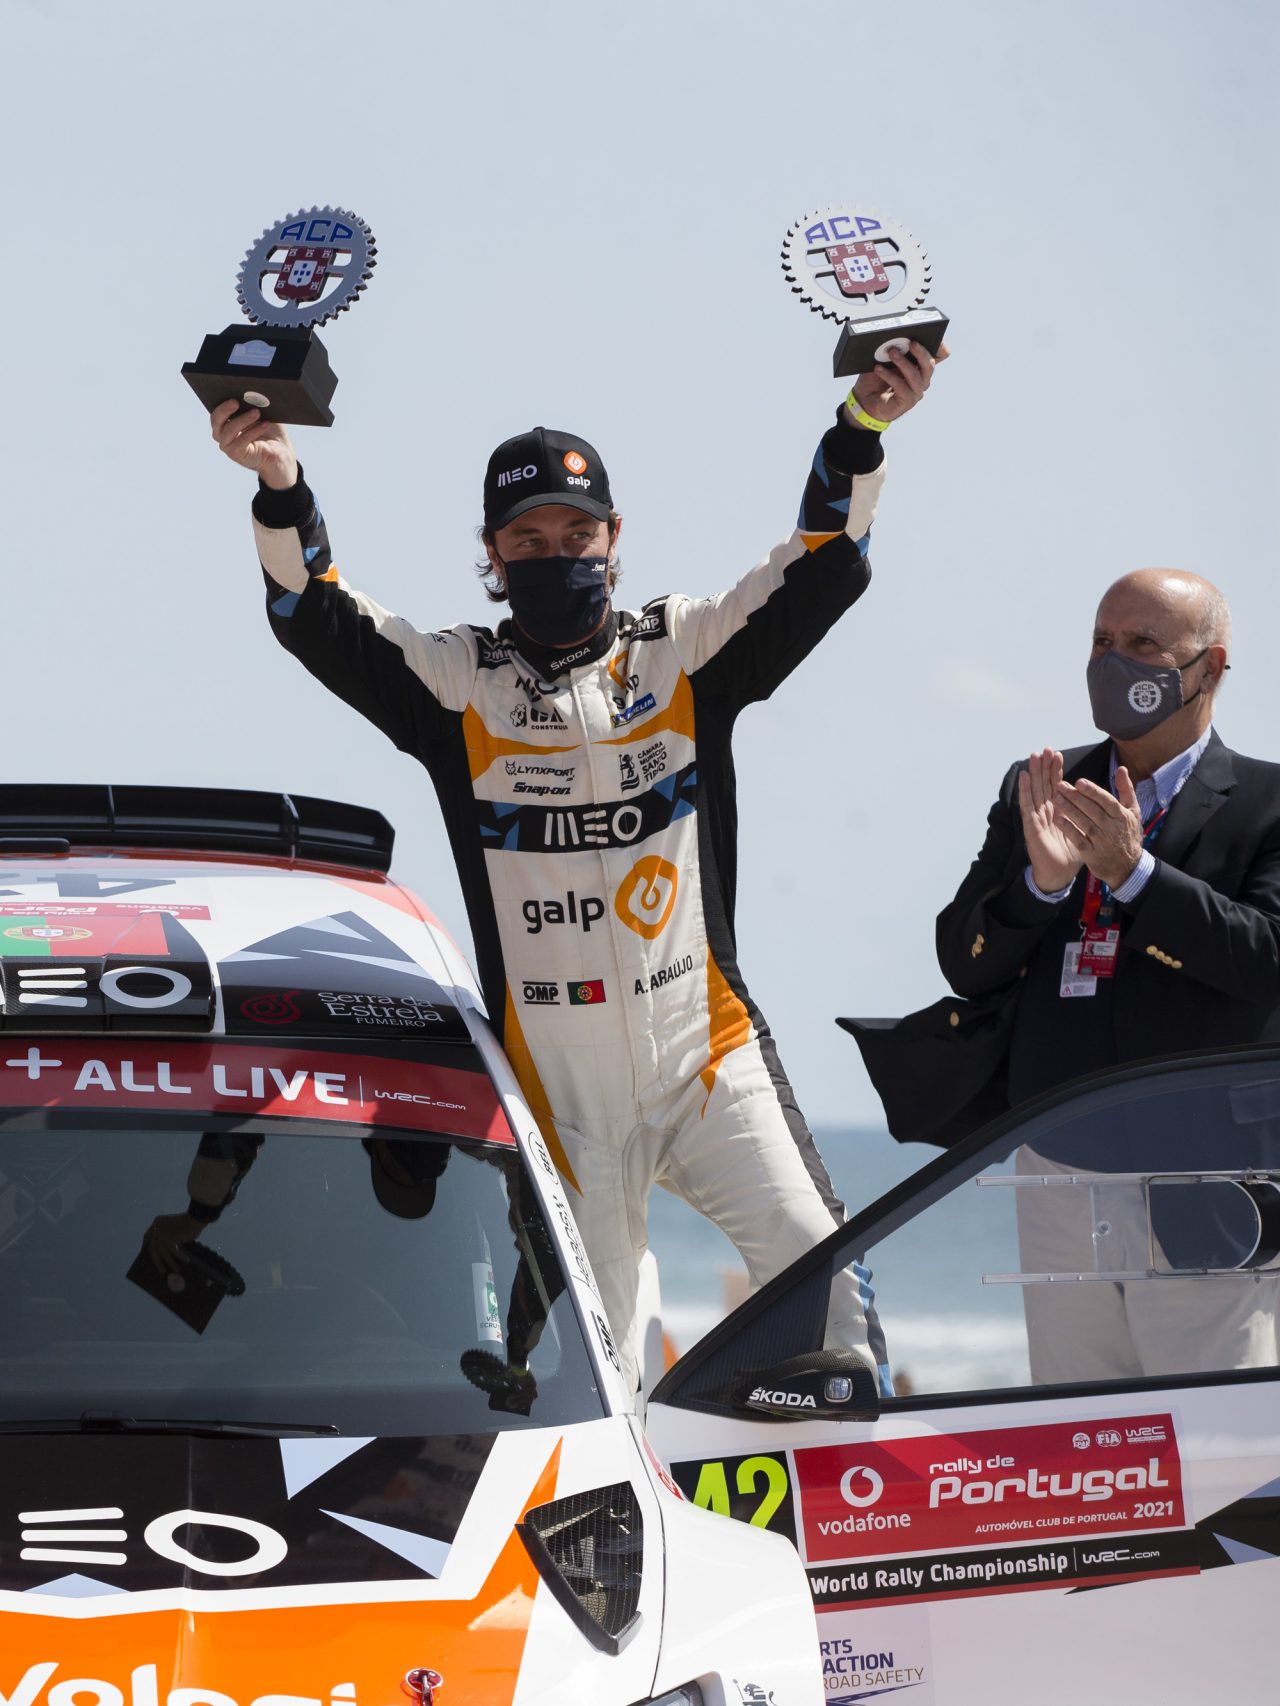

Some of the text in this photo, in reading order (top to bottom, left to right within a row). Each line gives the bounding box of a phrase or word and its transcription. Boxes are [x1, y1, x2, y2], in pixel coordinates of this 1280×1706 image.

[279, 219, 354, 243] ACP
[804, 216, 882, 244] ACP
[498, 464, 538, 487] MEO
[567, 475, 590, 489] galp
[513, 782, 571, 796] Snap-on
[544, 805, 642, 846] MEO
[523, 891, 605, 934] galp
[650, 955, 693, 990] ARAÚJO
[318, 992, 434, 1007] Serra da
[523, 983, 559, 1002] OMP
[324, 1002, 446, 1022] Estrela
[356, 1017, 426, 1027] FUMEIRO
[74, 1060, 192, 1094] ALL
[213, 1065, 349, 1106] LIVE
[749, 1386, 817, 1408] ŠKODA
[1097, 1433, 1120, 1444] FIA
[1125, 1426, 1166, 1438] WRC
[929, 1455, 1015, 1474] rally de
[929, 1457, 1169, 1509] Portugal
[1133, 1500, 1174, 1519] 2021
[818, 1512, 911, 1536] vodafone
[975, 1511, 1128, 1533] AUTOMÓVEL CLUB DE PORTUGAL
[810, 1553, 1068, 1595] World Rally Championship
[822, 1652, 895, 1674] ACTION
[824, 1667, 924, 1690] ROAD SAFETY
